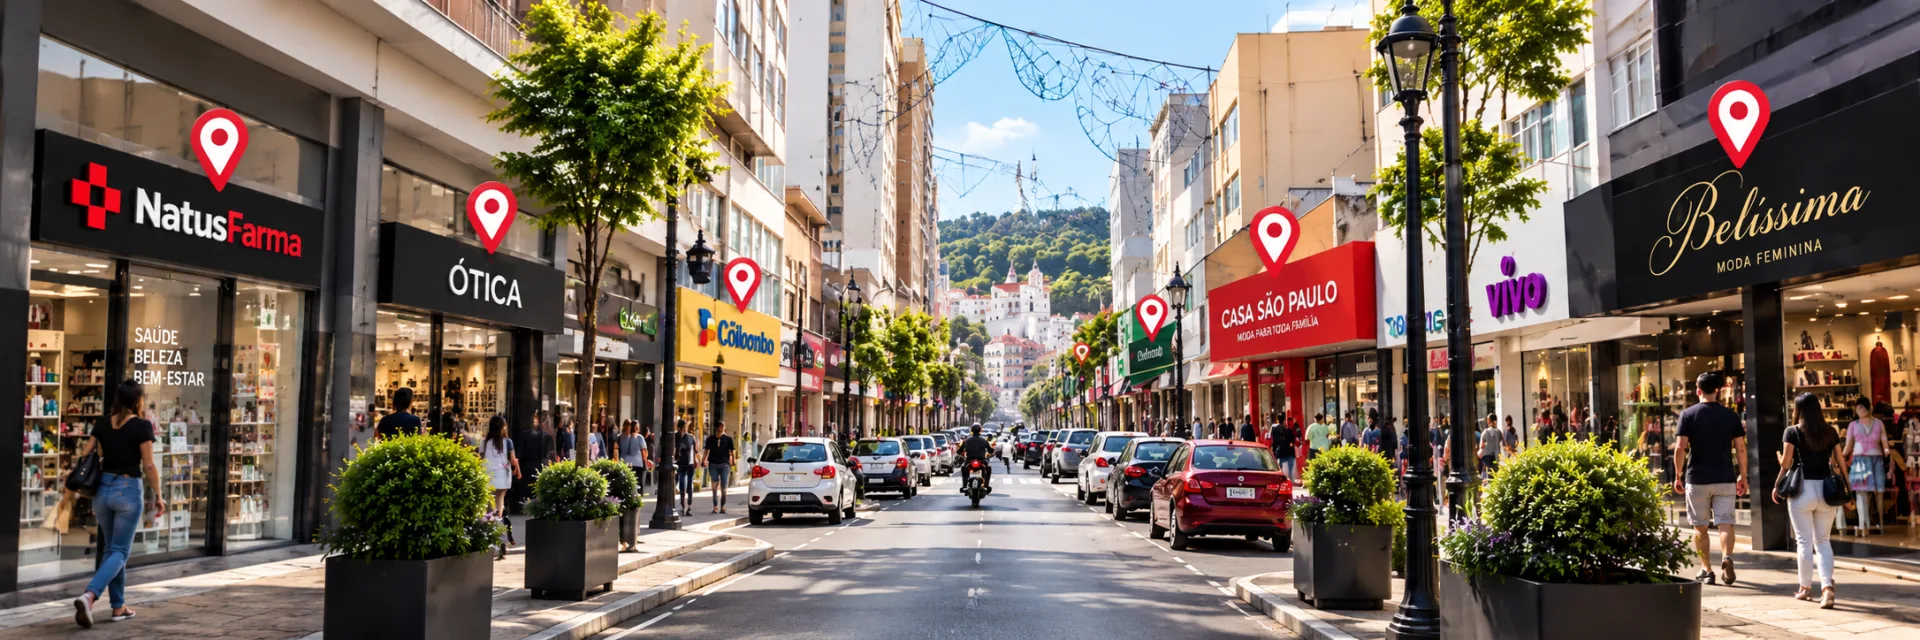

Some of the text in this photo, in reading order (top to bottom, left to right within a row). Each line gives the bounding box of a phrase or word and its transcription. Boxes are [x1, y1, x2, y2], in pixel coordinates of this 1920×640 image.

[135, 187, 302, 257] NatusFarma
[1649, 169, 1871, 277] Belíssima
[1716, 238, 1823, 273] MODA FEMININA
[449, 257, 523, 309] ÓTICA
[1221, 303, 1254, 329] CASA
[1288, 280, 1338, 313] PAULO
[134, 324, 179, 346] SAÚDE
[133, 369, 205, 387] BEM-ESTAR
[134, 348, 184, 366] BELEZA
